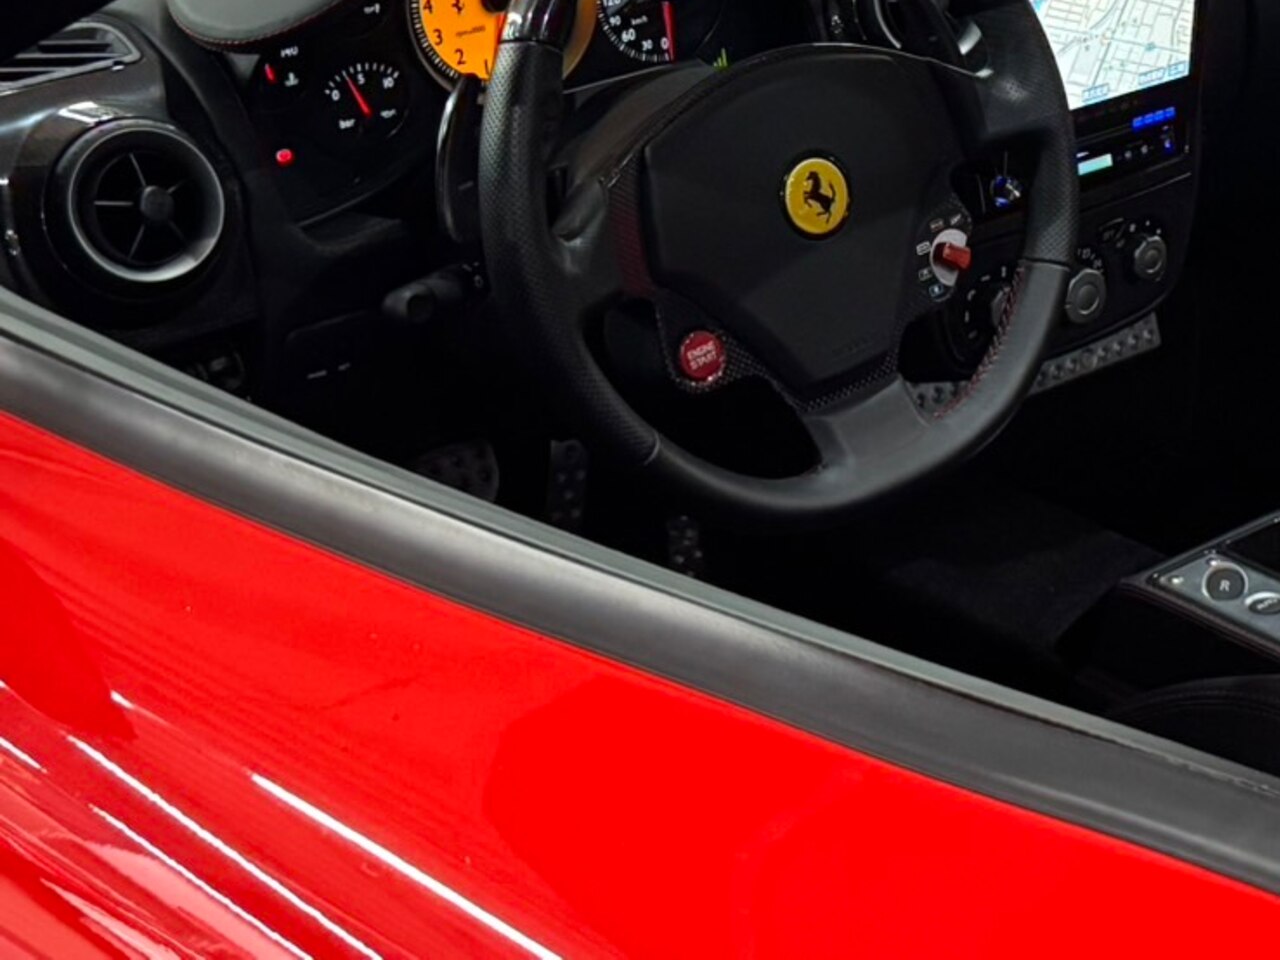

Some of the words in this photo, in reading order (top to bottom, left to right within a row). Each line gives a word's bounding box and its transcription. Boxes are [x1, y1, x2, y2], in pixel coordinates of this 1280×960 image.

[432, 29, 443, 46] 3
[621, 28, 636, 43] 60
[641, 40, 653, 51] 30
[660, 37, 669, 50] 0
[454, 48, 466, 65] 2
[357, 73, 366, 85] 5
[382, 76, 395, 89] 10
[331, 90, 340, 101] 0
[1219, 579, 1231, 592] R
